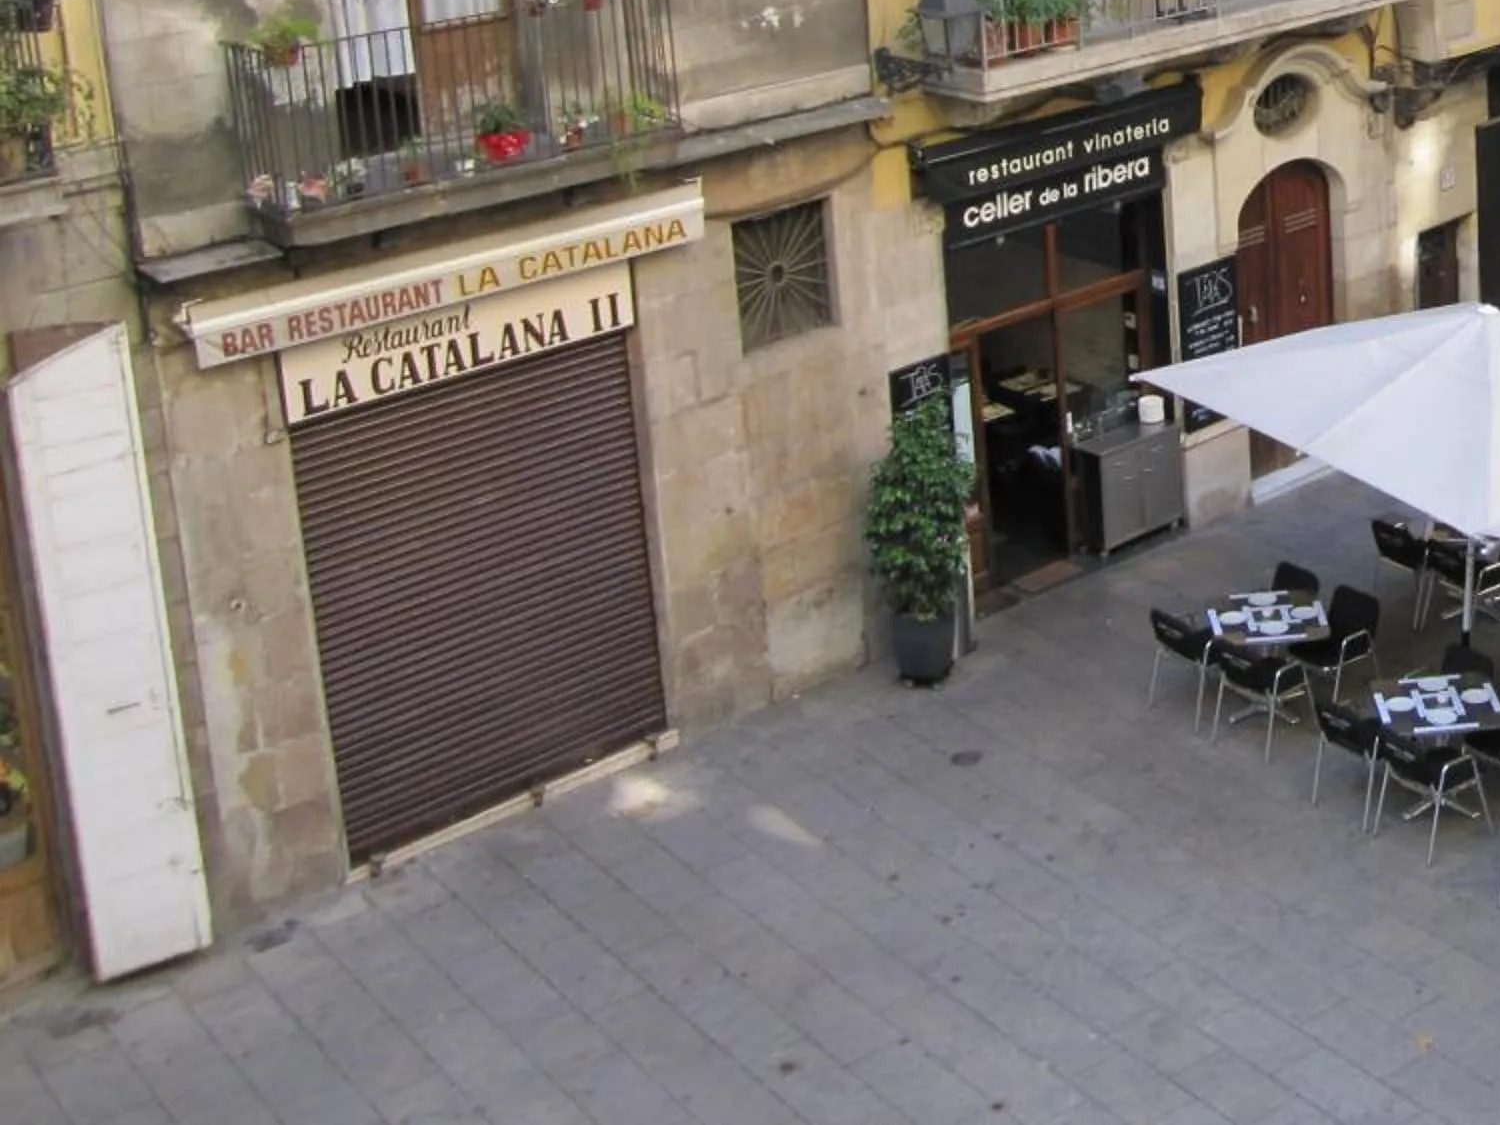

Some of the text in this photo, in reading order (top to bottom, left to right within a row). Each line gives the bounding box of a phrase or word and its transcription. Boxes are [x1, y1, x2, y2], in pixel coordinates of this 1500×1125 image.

[968, 116, 1170, 186] restaurant vinateria
[962, 155, 1150, 228] celler de la ribera
[221, 218, 687, 358] BAR RESTAURANT LA CATALANA
[298, 292, 621, 418] LA CATALANA II
[340, 303, 475, 364] Restaurant
